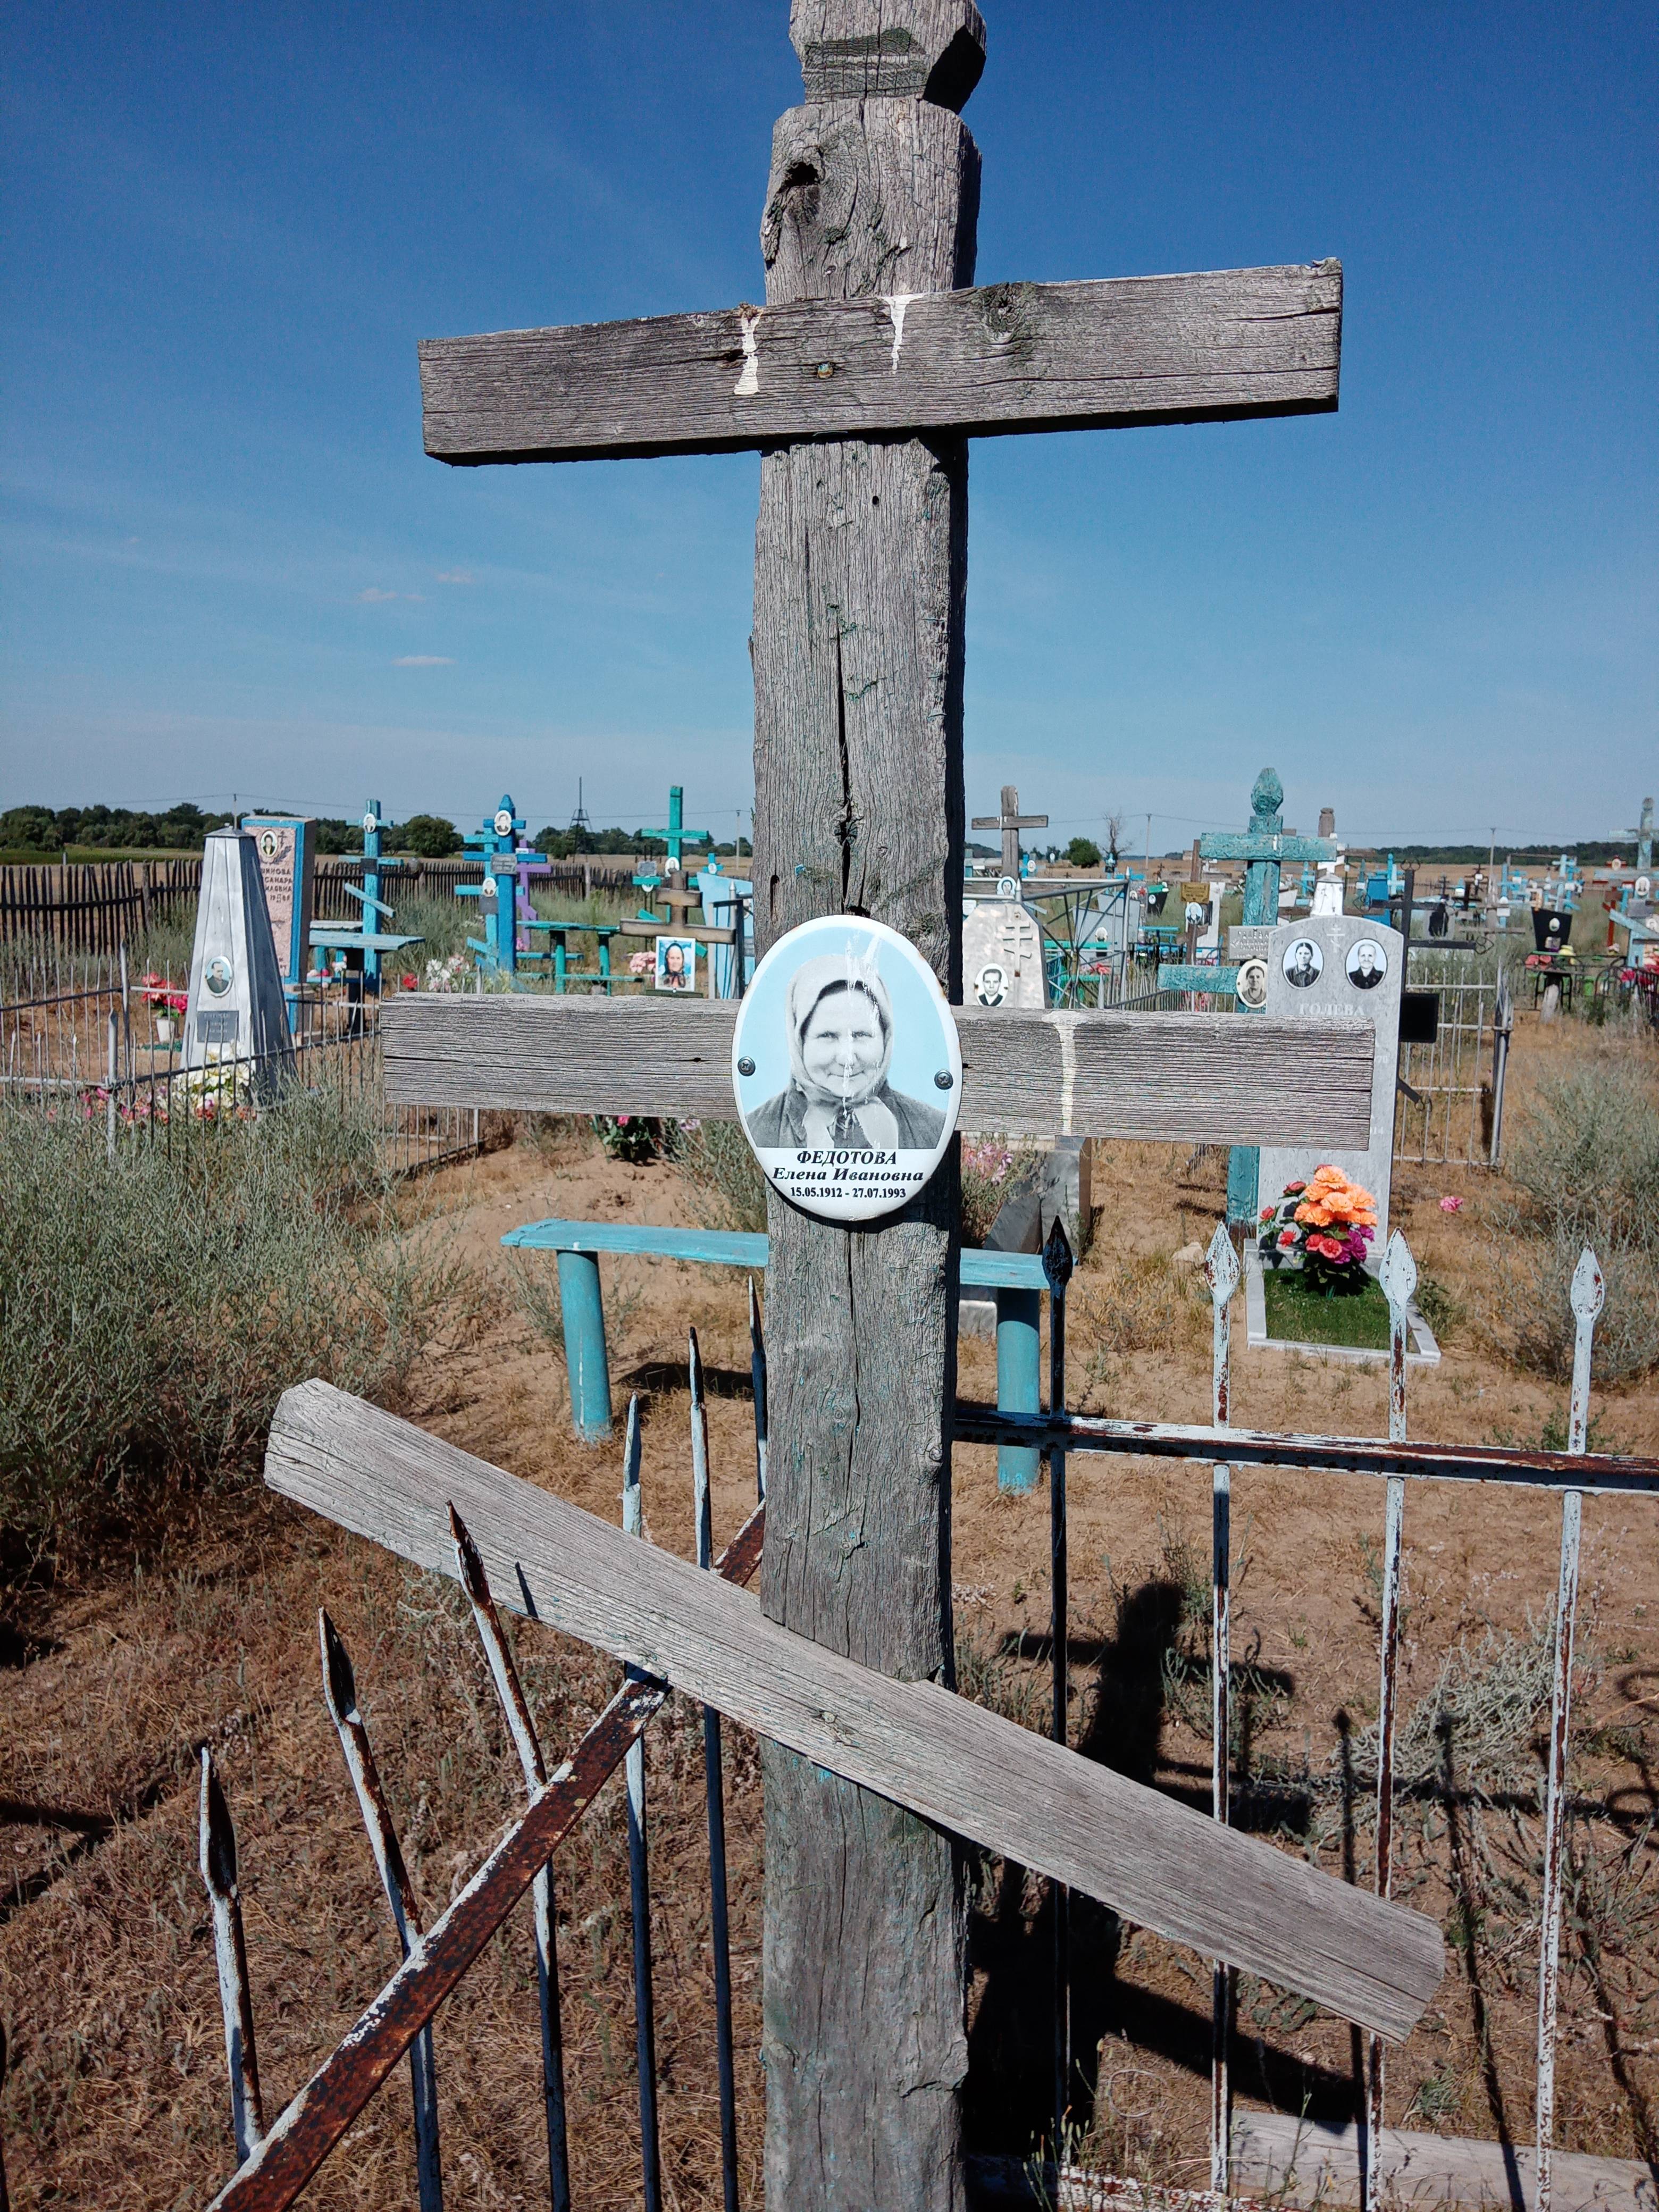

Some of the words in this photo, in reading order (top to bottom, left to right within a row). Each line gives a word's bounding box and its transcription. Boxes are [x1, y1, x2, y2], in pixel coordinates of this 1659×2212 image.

[1299, 1002, 1365, 1016] ГОЛЕВА
[797, 1151, 896, 1167] ФЕДОТОВА
[773, 1167, 826, 1180] Елена
[832, 1168, 924, 1181] Ивановна
[791, 1187, 842, 1197] 15.05.1912
[853, 1188, 906, 1198] 27.07.1993
